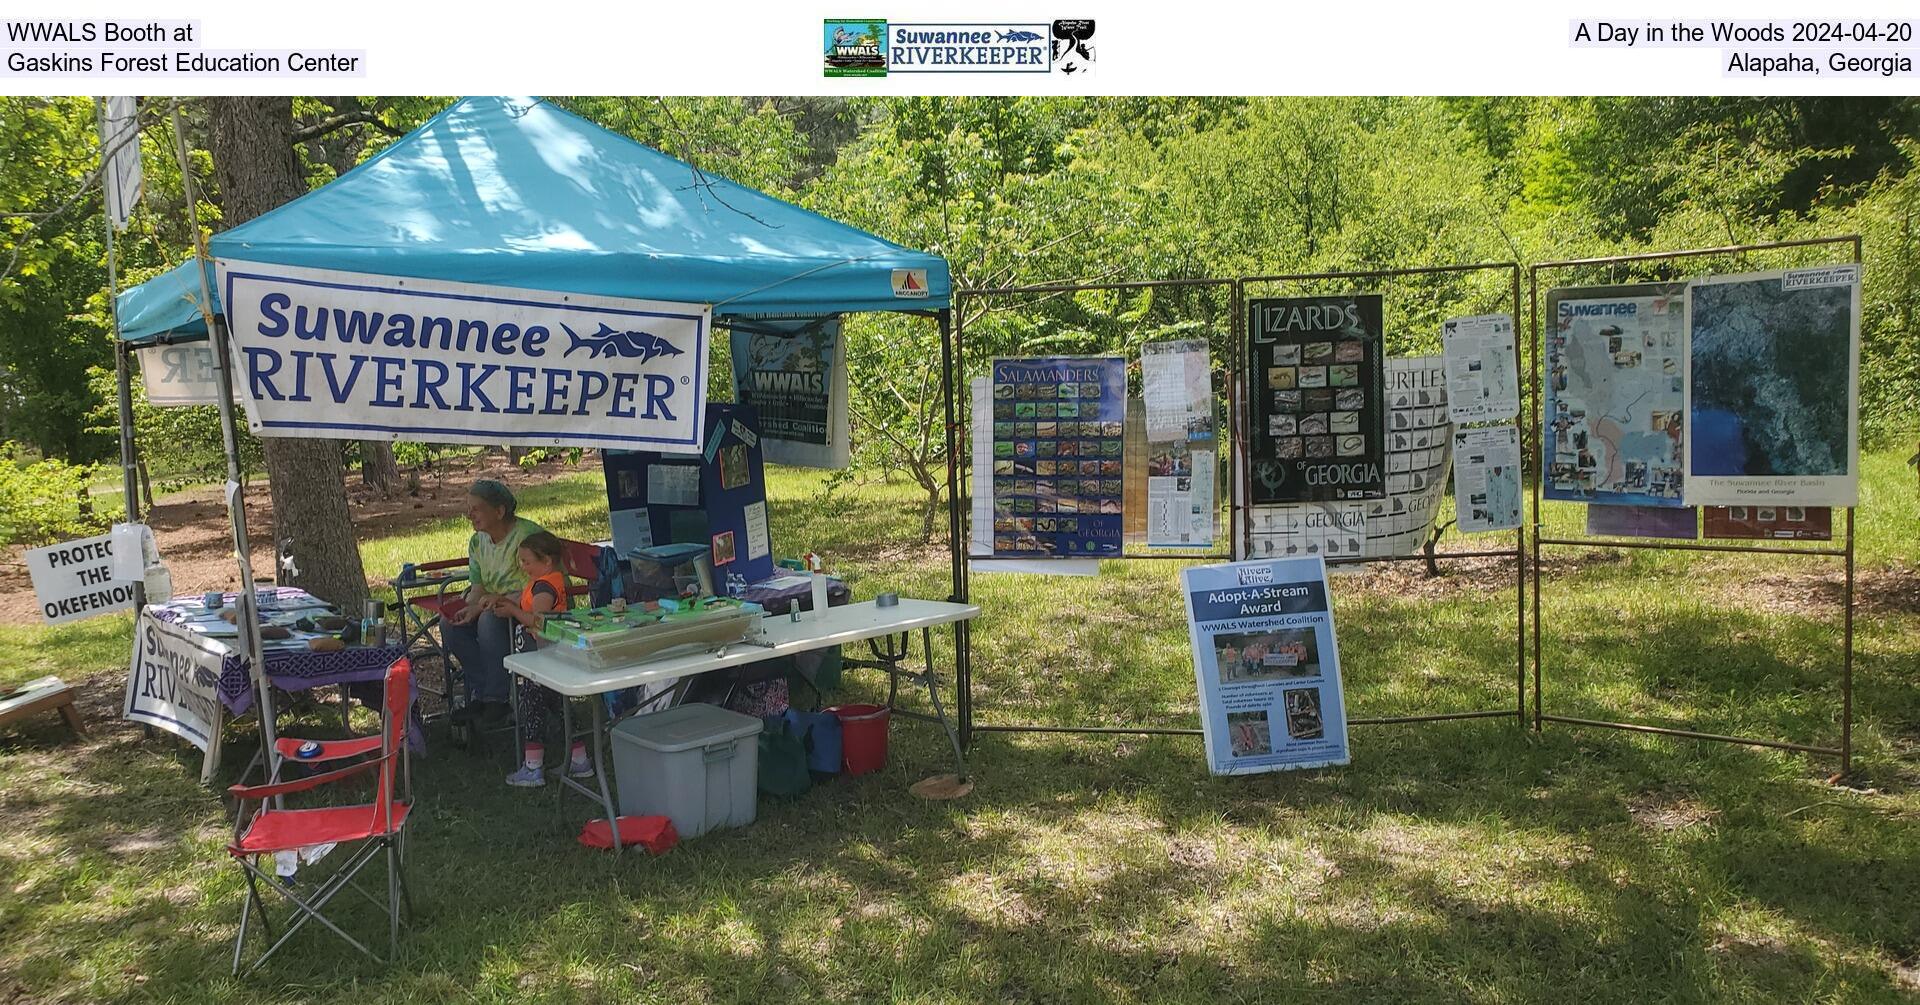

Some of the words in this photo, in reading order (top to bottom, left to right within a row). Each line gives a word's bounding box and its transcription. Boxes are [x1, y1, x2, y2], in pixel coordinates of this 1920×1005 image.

[1786, 273, 1854, 286] RIVERKEEPER
[1788, 271, 1831, 279] Suwannee
[1559, 302, 1637, 317] Suwannee
[258, 293, 549, 357] Suwannee
[755, 371, 822, 394] WWALS
[1384, 368, 1446, 390] URTLES
[1305, 463, 1381, 485] GEORGIA
[1305, 511, 1365, 528] GEORGIA
[1078, 529, 1120, 537] GEORGIA
[48, 540, 113, 568] PROTEC
[77, 566, 112, 586] THE
[1239, 567, 1271, 576] Rivers
[1208, 586, 1309, 604] Adopt-A-Stream
[1240, 601, 1282, 615] Award
[1202, 622, 1237, 632] WWALS
[1237, 618, 1285, 630] Watershed
[1286, 615, 1324, 625] Coalition
